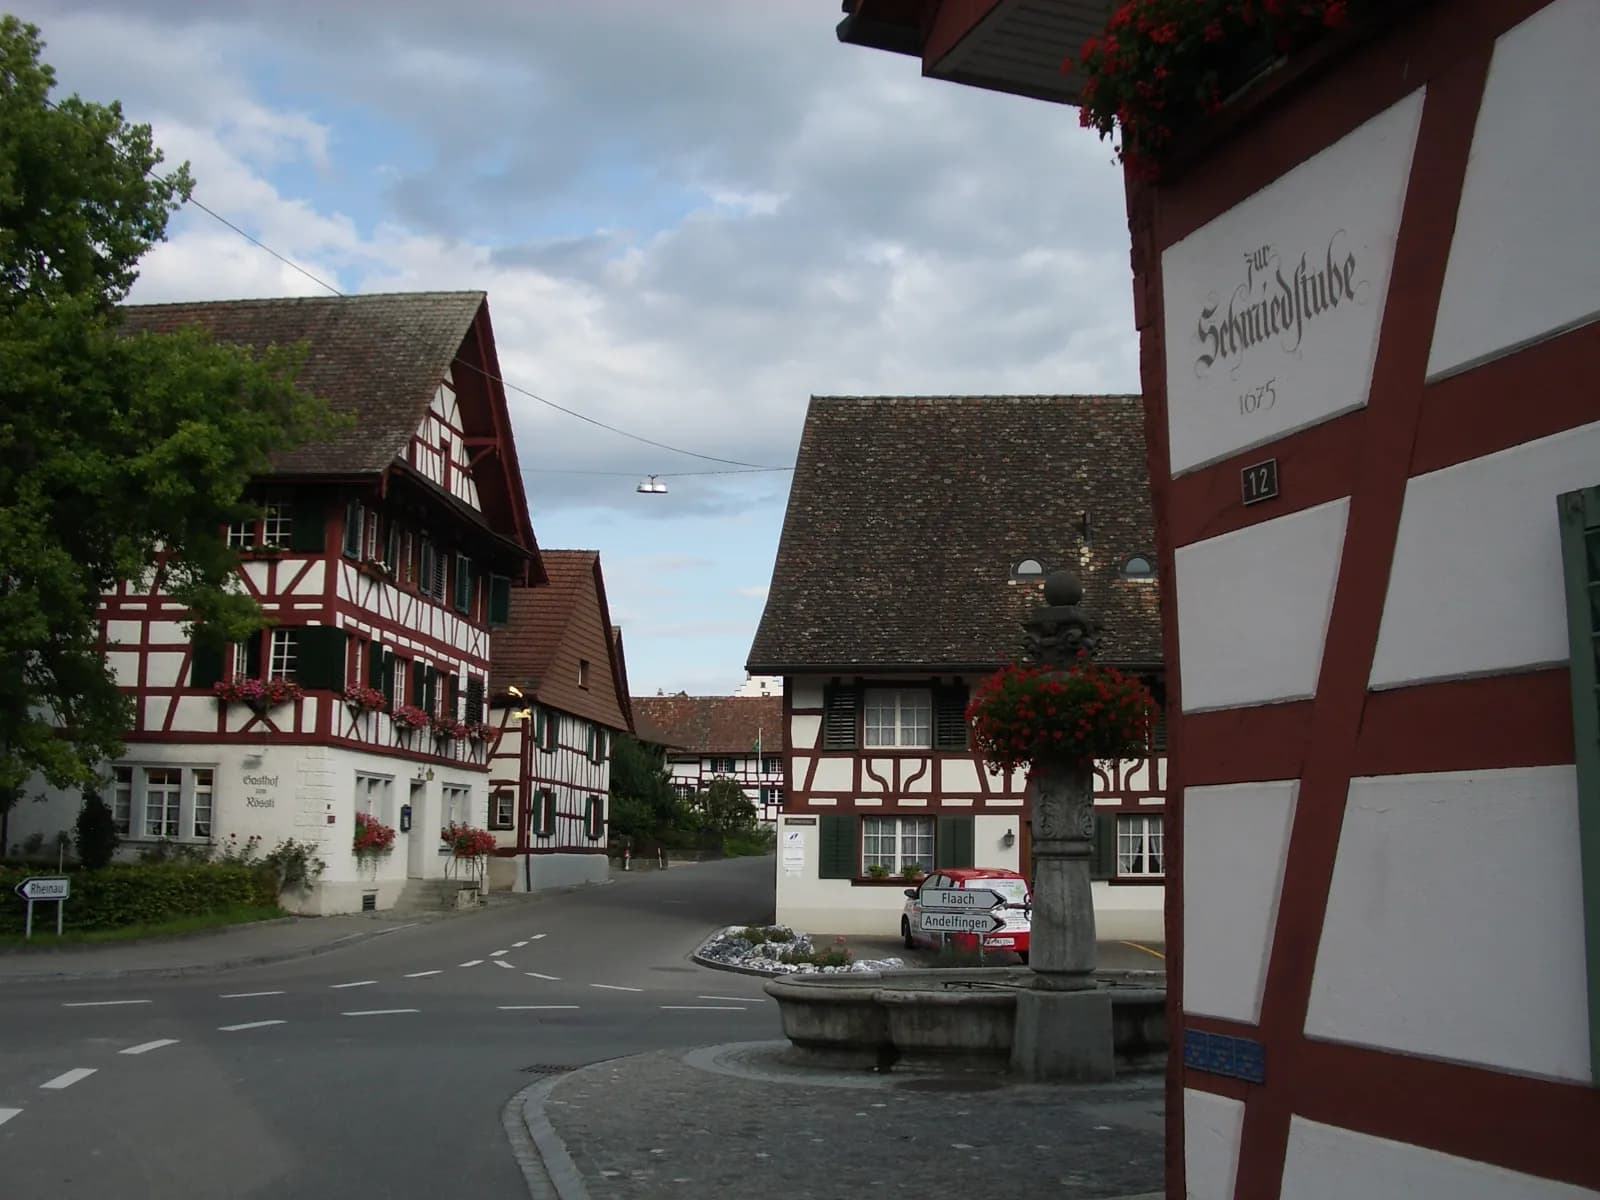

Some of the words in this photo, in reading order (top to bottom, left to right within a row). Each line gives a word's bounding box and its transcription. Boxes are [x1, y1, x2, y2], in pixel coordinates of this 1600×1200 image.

[1239, 377, 1277, 415] 1675
[1248, 467, 1270, 496] 12
[242, 775, 279, 787] Gasthof
[30, 883, 64, 894] Rheinau
[941, 892, 975, 905] Flaach
[924, 915, 988, 930] Andelfingen
